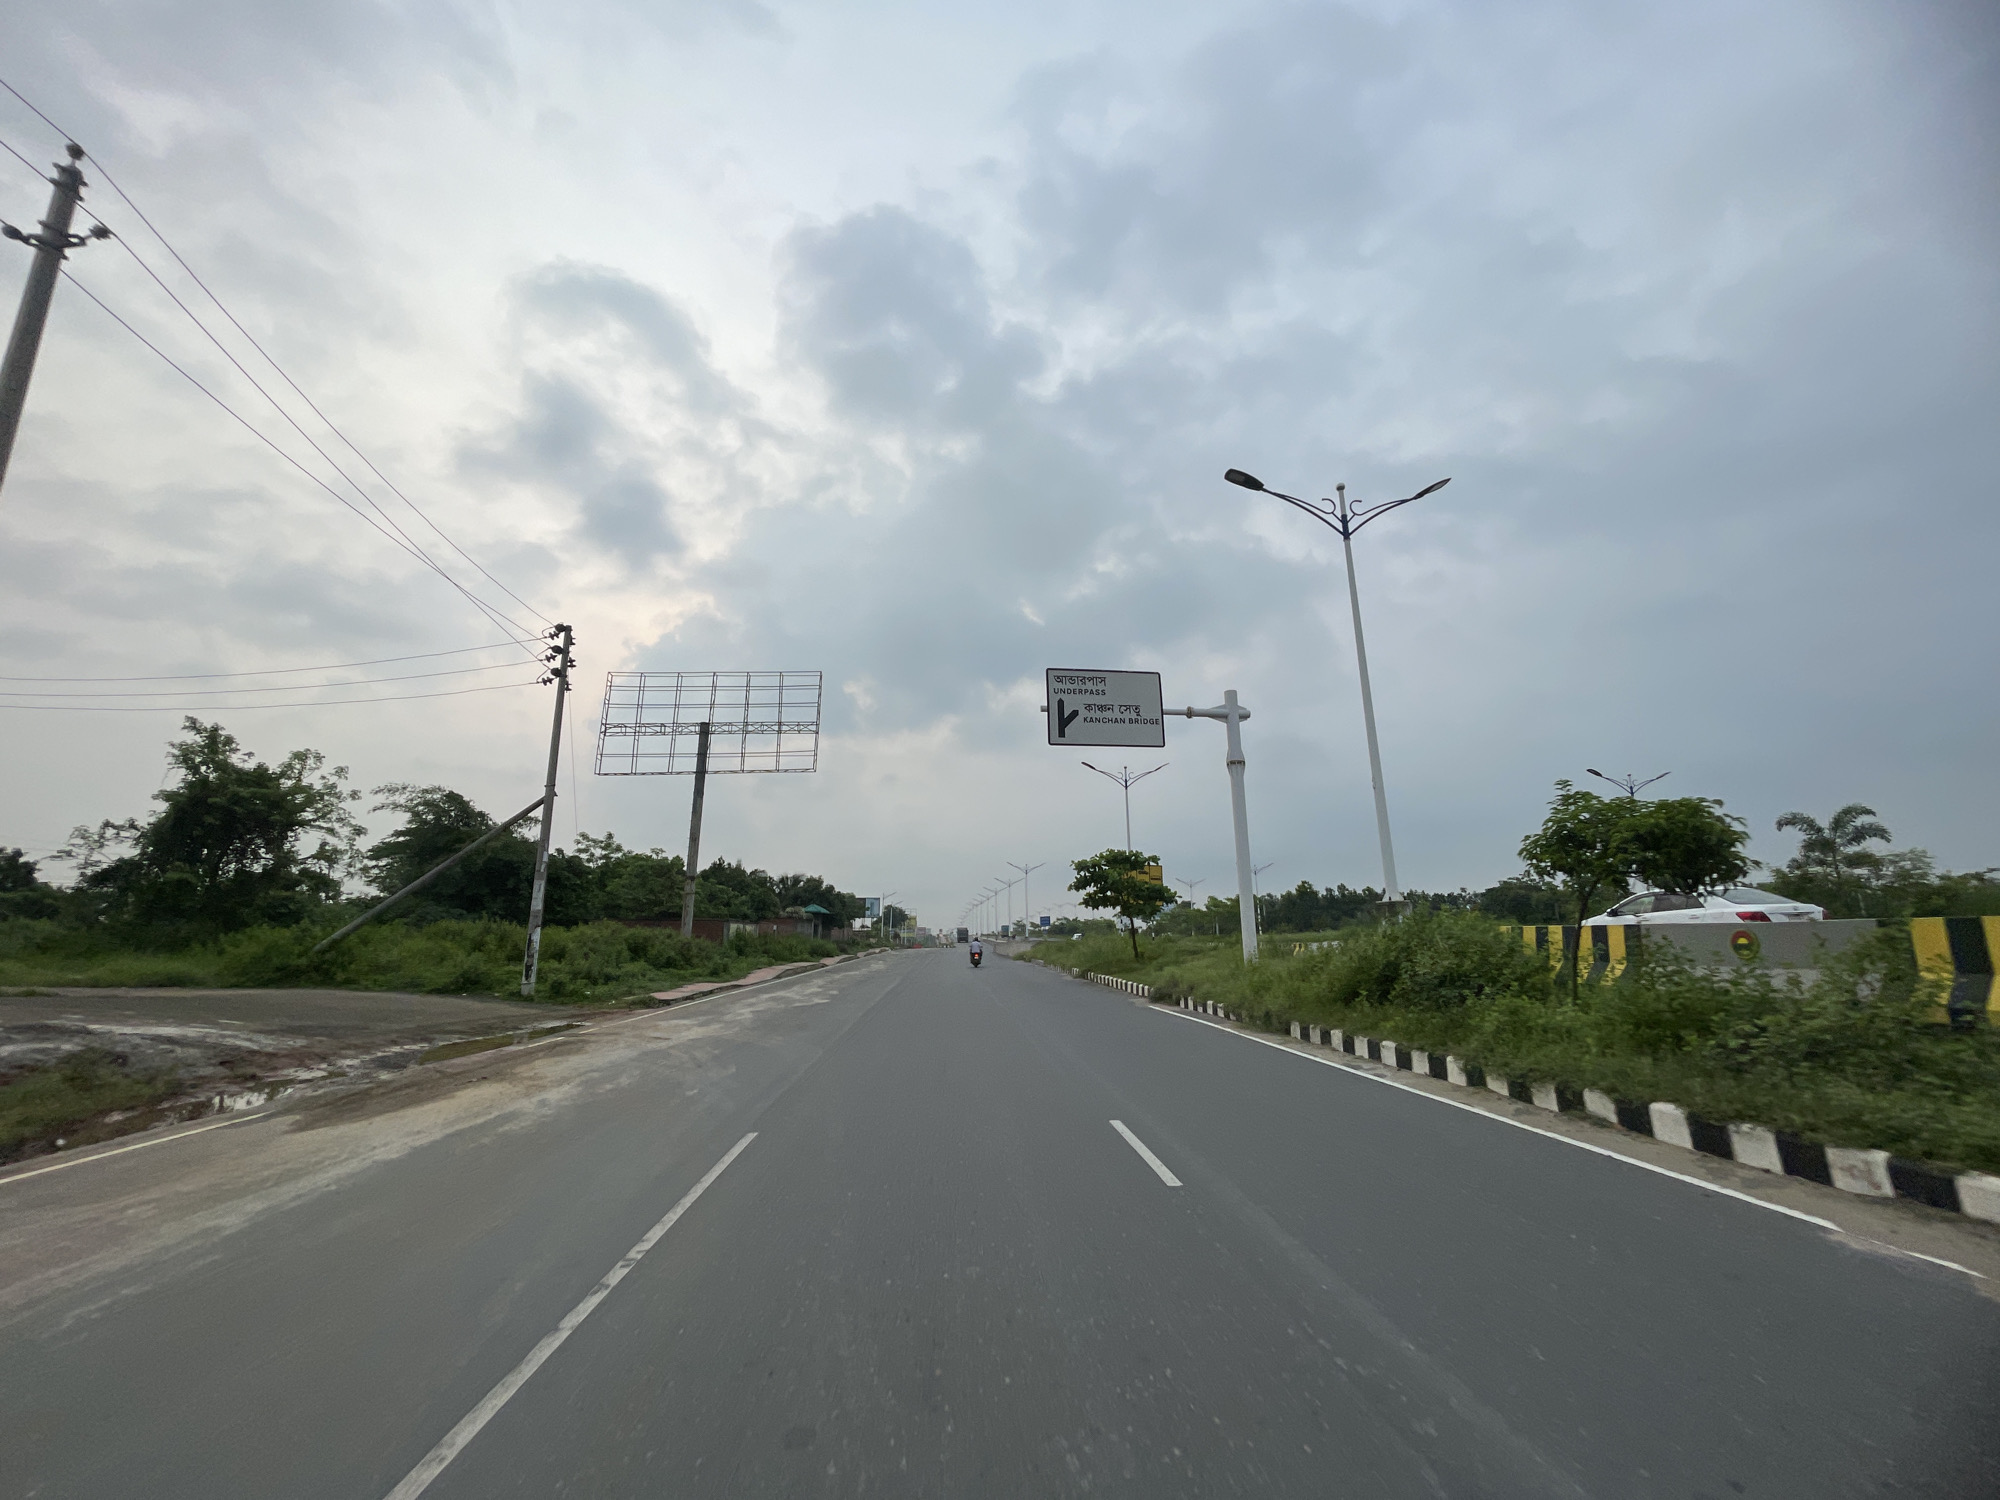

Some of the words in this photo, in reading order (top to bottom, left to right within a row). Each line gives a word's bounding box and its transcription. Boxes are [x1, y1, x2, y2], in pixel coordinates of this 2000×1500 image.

[1053, 688, 1106, 696] UNDERPASS
[1083, 703, 1114, 714] কাঞ্চন
[1118, 704, 1142, 717] সেতু
